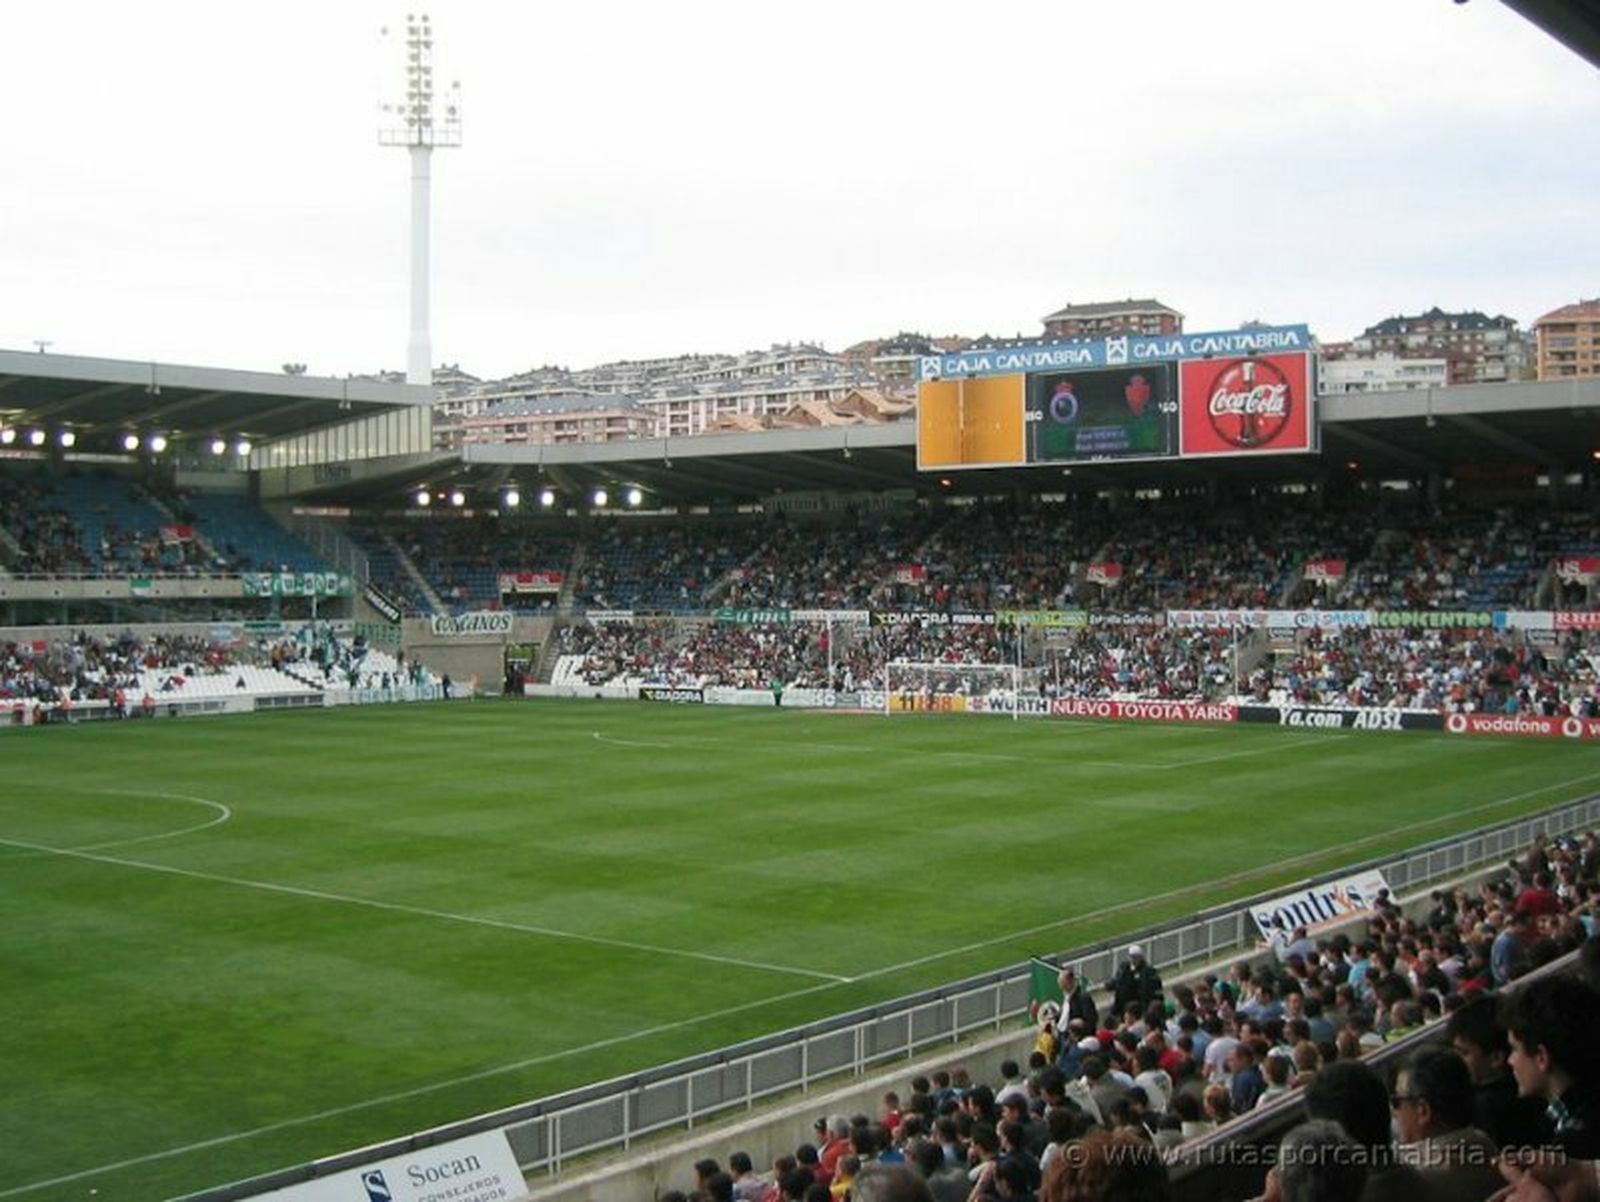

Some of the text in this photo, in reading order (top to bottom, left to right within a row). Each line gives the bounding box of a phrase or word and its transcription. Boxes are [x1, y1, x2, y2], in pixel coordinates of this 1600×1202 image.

[1133, 331, 1300, 358] CAJA CANTABRIA
[946, 349, 1093, 373] CAJA CANTABRIA
[1379, 611, 1491, 628] COPICENTRO
[1053, 700, 1232, 720] NUEVO TOYOTA YARIS
[1279, 707, 1403, 730] Ya.com ADSL
[1472, 716, 1551, 733] vodafone
[406, 1155, 481, 1187] Socan
